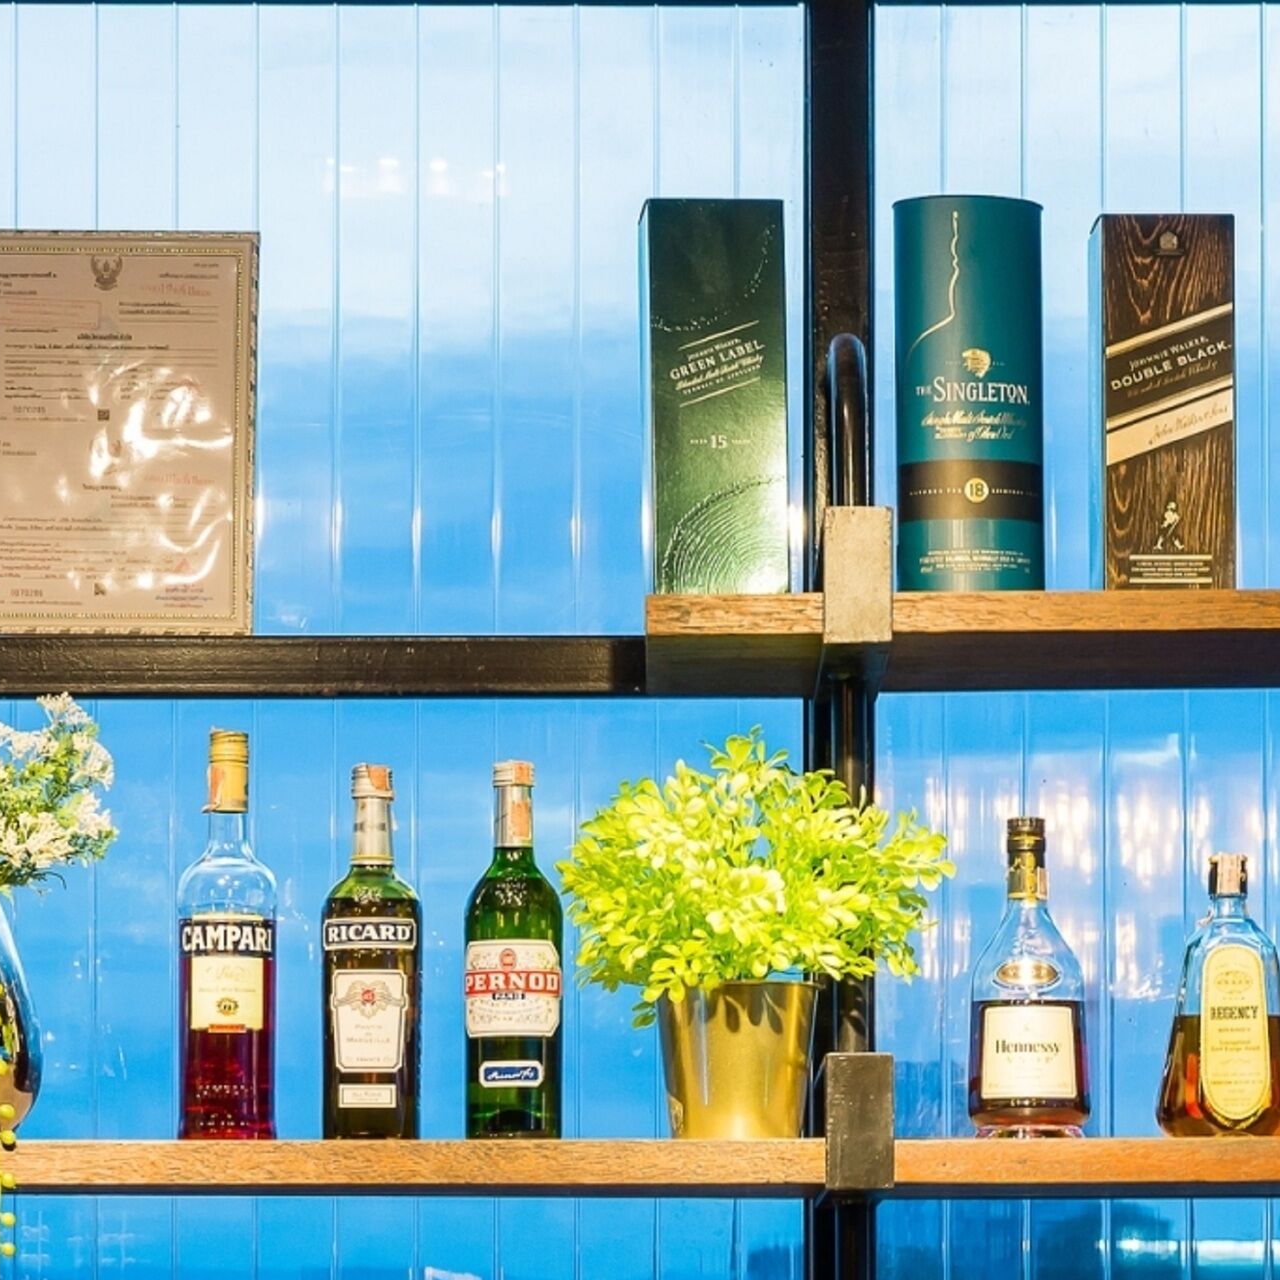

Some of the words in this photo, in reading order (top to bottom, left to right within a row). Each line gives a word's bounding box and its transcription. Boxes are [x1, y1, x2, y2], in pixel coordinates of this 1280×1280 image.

[669, 356, 716, 380] GREEN
[719, 340, 766, 362] LABEL
[1110, 362, 1172, 391] DOUBLE
[710, 434, 727, 449] 15
[969, 483, 985, 497] 18
[181, 925, 272, 953] CAMPARI
[328, 922, 411, 943] RICARD
[465, 972, 559, 991] PERNOD
[1210, 1006, 1259, 1020] REGENCY
[995, 1039, 1061, 1057] Hennessy
